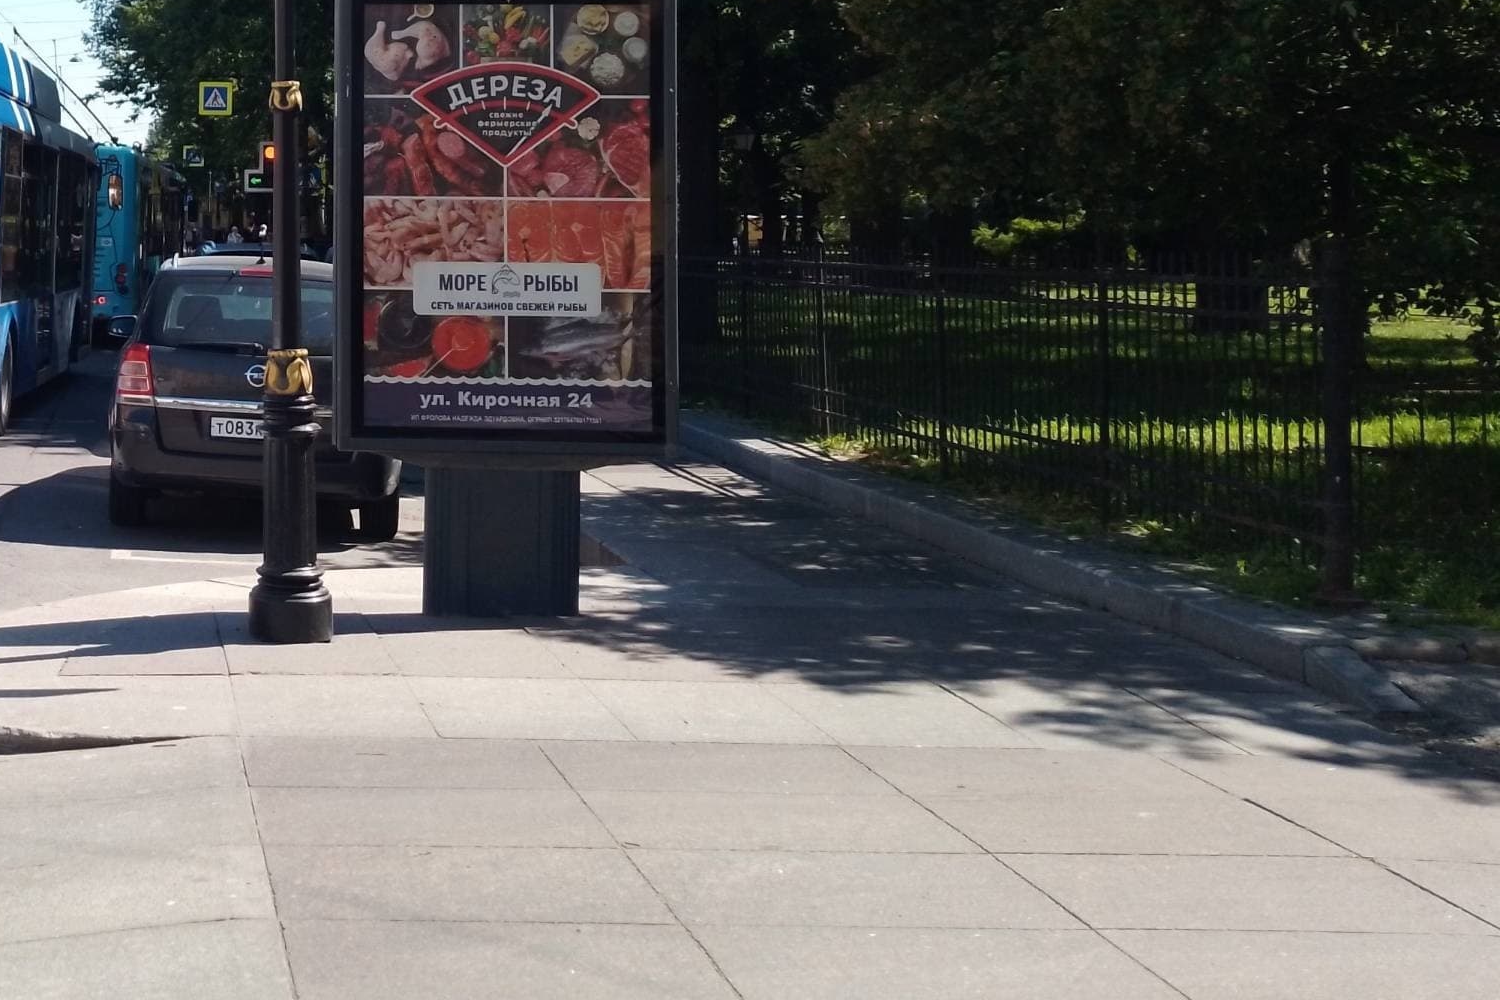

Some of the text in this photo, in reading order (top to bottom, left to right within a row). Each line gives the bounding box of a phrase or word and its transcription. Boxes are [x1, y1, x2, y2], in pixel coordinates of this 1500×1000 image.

[446, 74, 562, 110] ДЕРЕЗА
[439, 273, 579, 292] МОРЕ РЫБЫ
[430, 301, 588, 312] СЕТЬ МАГАЗИНОВ СВЕЖЕЙ РЫБЫ
[419, 391, 593, 410] ул. Кирочная 24
